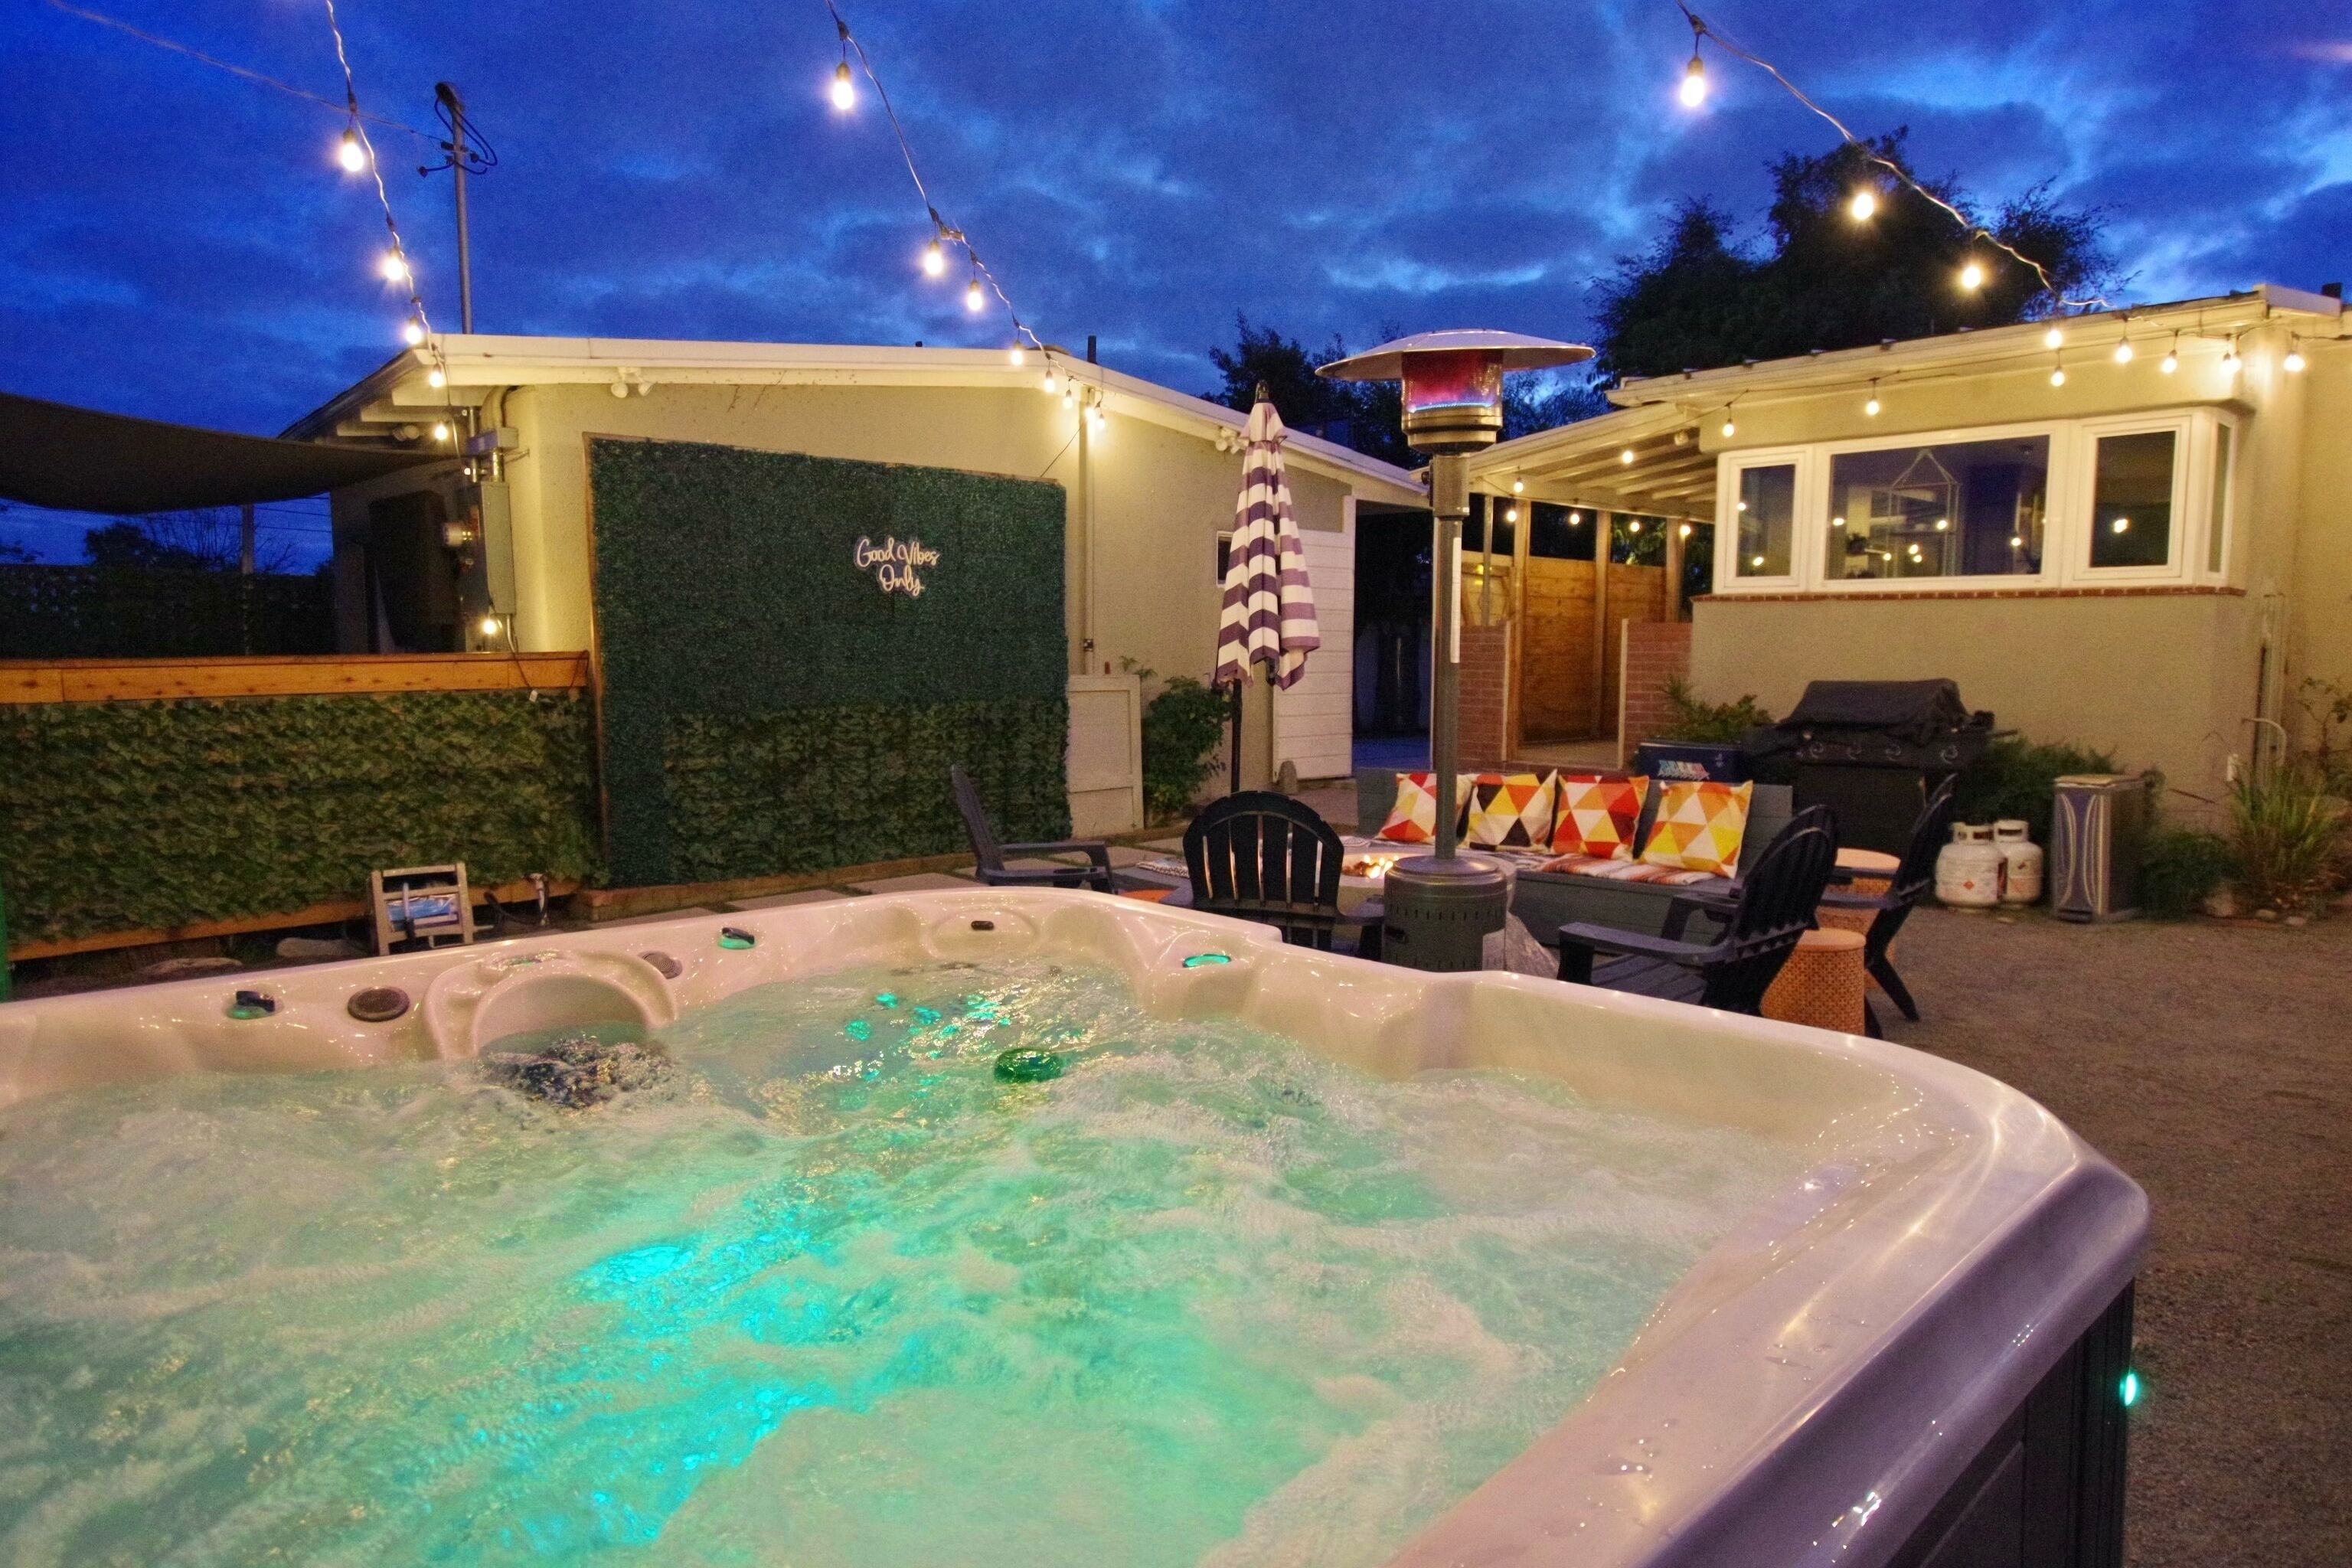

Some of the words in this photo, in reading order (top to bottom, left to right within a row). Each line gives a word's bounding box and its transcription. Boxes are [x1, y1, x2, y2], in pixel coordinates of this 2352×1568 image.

[857, 537, 897, 567] Good
[897, 541, 941, 566] Vibes
[880, 564, 926, 596] Only
